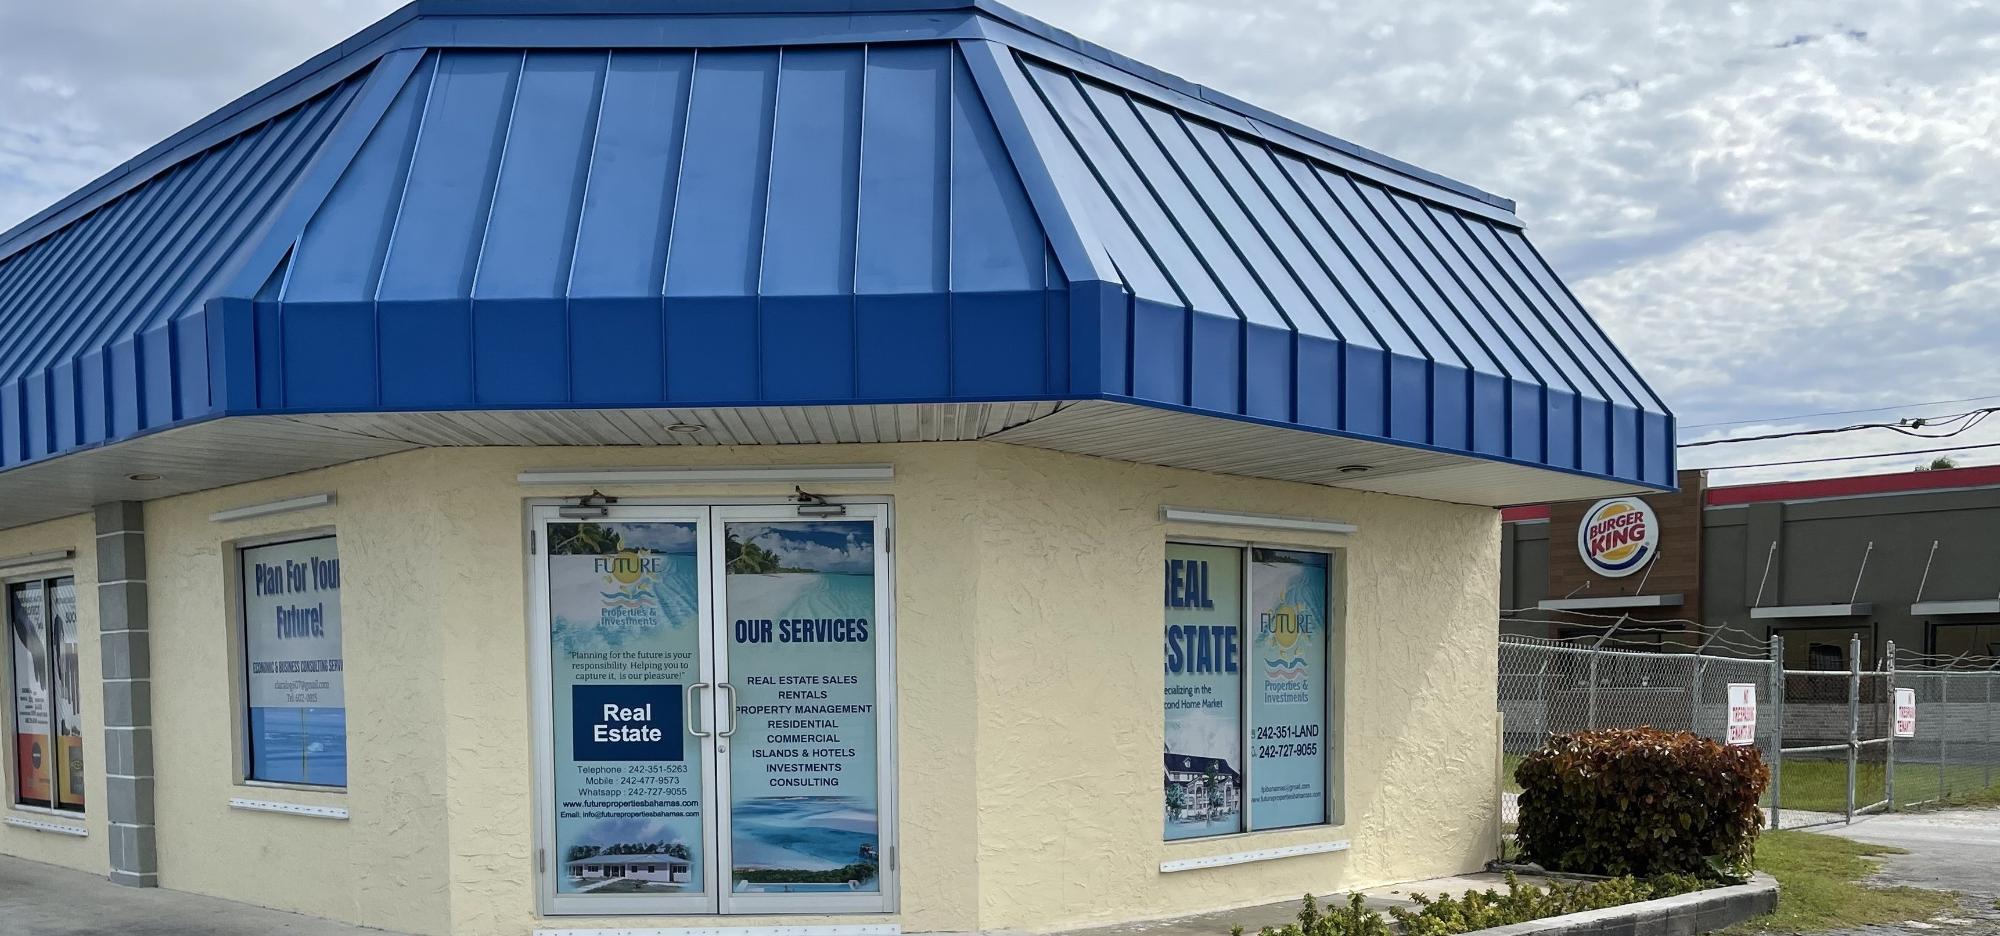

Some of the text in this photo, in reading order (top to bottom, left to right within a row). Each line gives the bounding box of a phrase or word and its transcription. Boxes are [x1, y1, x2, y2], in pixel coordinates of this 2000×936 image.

[1590, 511, 1644, 539] BURGER
[1591, 523, 1645, 556] KING
[594, 557, 661, 573] FUTURE
[255, 562, 284, 596] Plan
[286, 559, 307, 593] For
[601, 607, 657, 618] Properties &
[276, 602, 324, 640] Future!
[601, 617, 658, 627] Investments
[1260, 613, 1314, 634] FUTURE
[735, 618, 869, 643] OUR SERVICES
[1165, 624, 1238, 674] STATE
[609, 650, 621, 660] for
[622, 650, 636, 660] the
[637, 650, 664, 660] future
[665, 651, 672, 659] is
[673, 651, 693, 660] your
[630, 661, 662, 671] Helping
[664, 661, 679, 670] you
[680, 661, 689, 669] to
[575, 673, 606, 681] capture
[620, 671, 627, 679] is
[628, 672, 642, 680] our
[747, 675, 858, 685] REAL ESTATE SALES
[1194, 687, 1200, 695] in
[1201, 684, 1212, 694] the
[1265, 679, 1309, 692] Properties &
[778, 690, 828, 700] RENTALS
[1265, 692, 1309, 703] Investments
[795, 704, 873, 714] MANAGEMENT
[1181, 699, 1201, 710] Home
[1202, 698, 1223, 709] Market
[603, 703, 651, 721] Real
[768, 719, 839, 729] RESIDENTIAL
[593, 724, 662, 742] Estate
[1257, 724, 1319, 740] 242-351-LAND
[767, 734, 840, 743] COMMERCIAL
[752, 748, 855, 758] ISLANDS & HOTELS
[1259, 742, 1317, 758] 242-727-9055
[577, 766, 622, 776] Telephone
[628, 765, 688, 773] 242-351-5263
[766, 763, 842, 772] INVESTMENTS
[585, 776, 614, 785] Mobile
[620, 776, 680, 785] 242-477-9573
[769, 777, 839, 787] CONSULTING
[578, 788, 622, 797] Whatsapp
[628, 788, 687, 796] 242-727-9055
[562, 799, 699, 808] www.futurepropertiesbahamas.com
[582, 810, 700, 819] info@futurepropertiesbahamas.com
